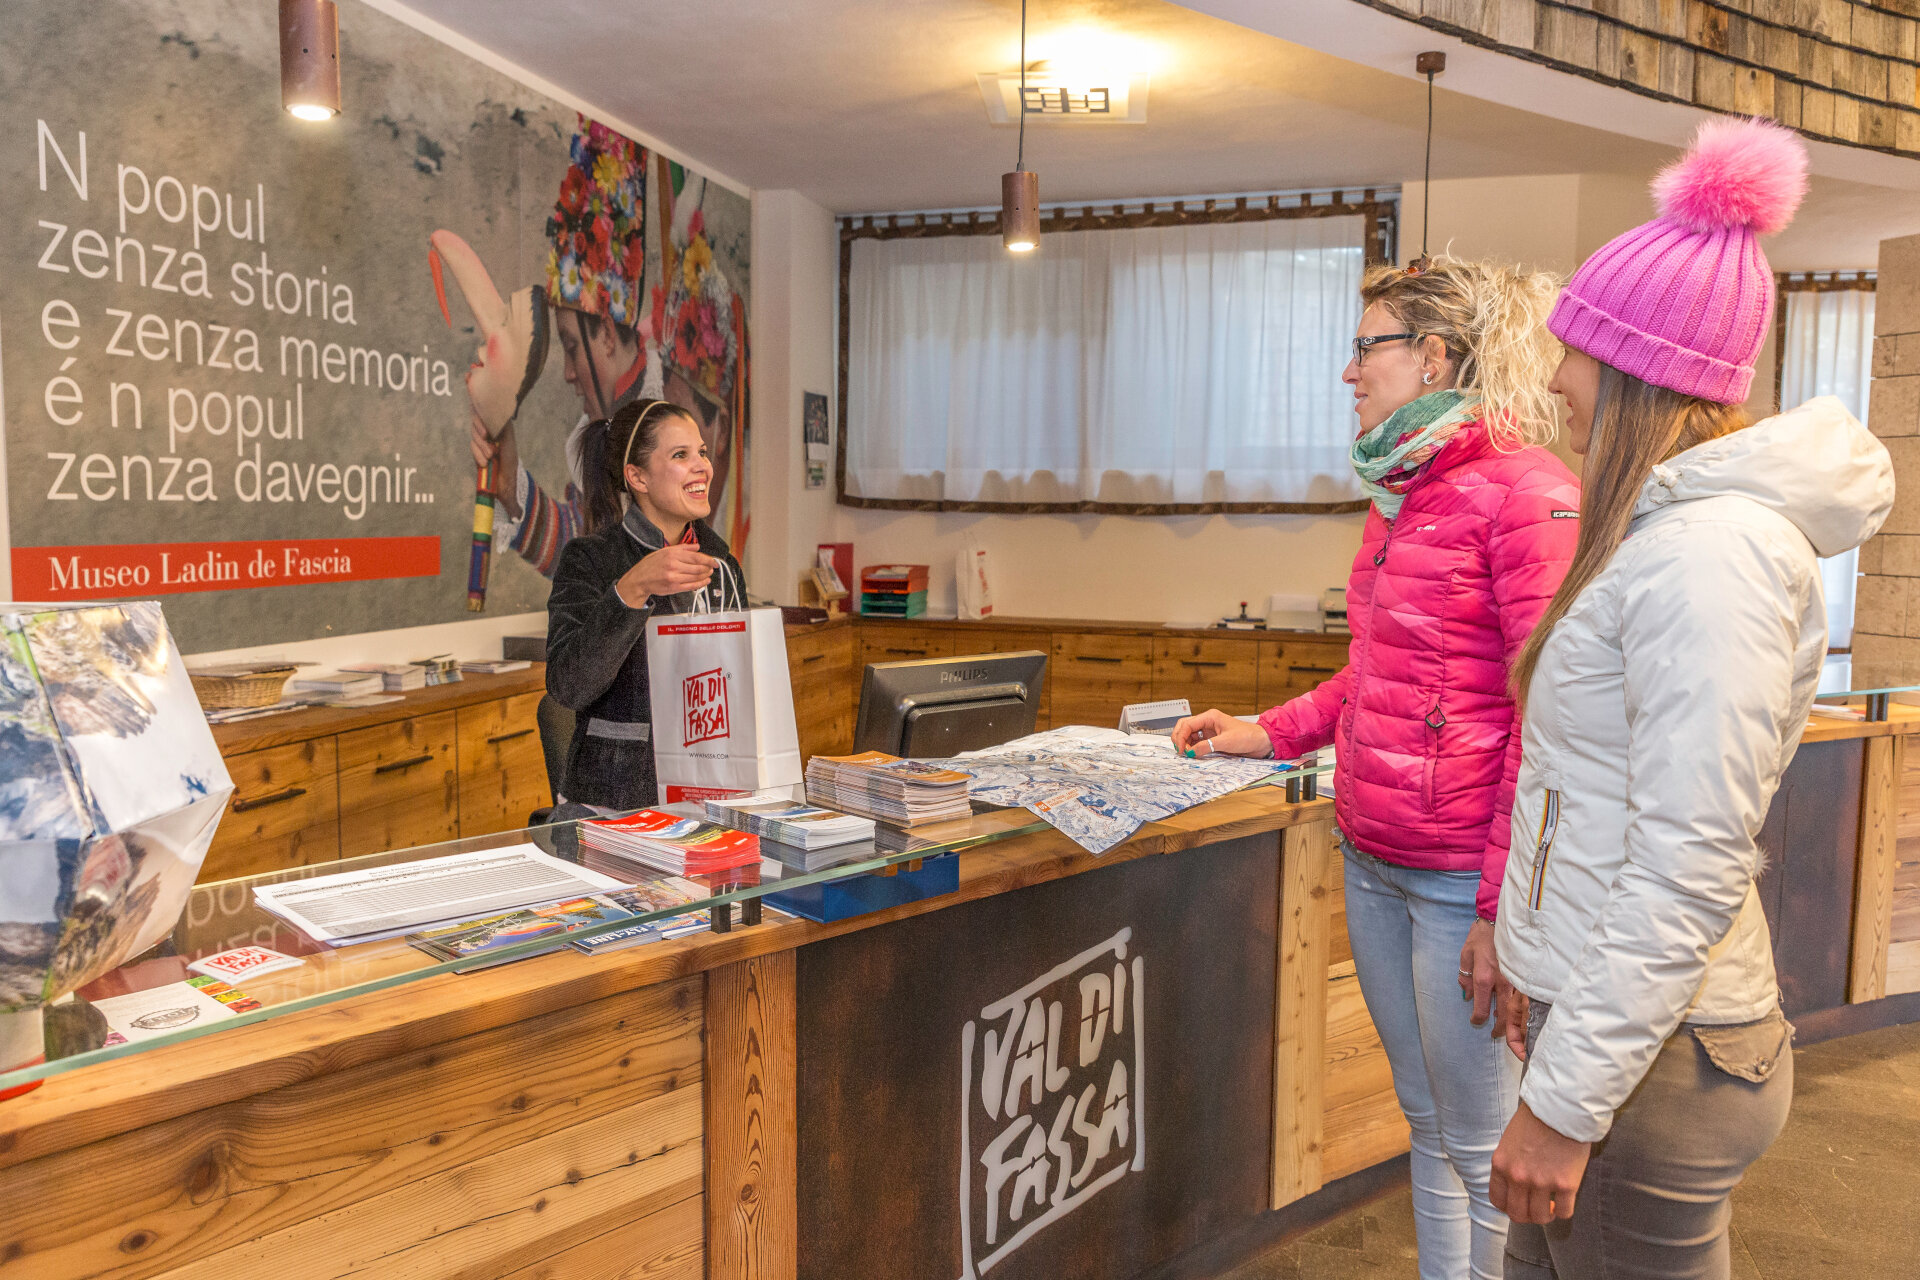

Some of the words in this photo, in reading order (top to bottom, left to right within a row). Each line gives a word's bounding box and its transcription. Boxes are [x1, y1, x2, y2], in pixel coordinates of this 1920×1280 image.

[37, 118, 89, 200] N
[117, 162, 266, 250] popul
[37, 219, 213, 299] zenza
[230, 251, 357, 325] storia
[41, 299, 81, 349] e
[105, 306, 263, 373] zenza
[279, 333, 452, 397] memoria
[44, 356, 83, 426] é
[109, 380, 142, 429] n
[168, 382, 304, 456] popul
[46, 451, 217, 502] zenza
[234, 442, 435, 520] davegnir...
[48, 555, 151, 591] Museo
[159, 550, 240, 586] Ladin
[247, 549, 277, 579] de
[283, 547, 353, 578] Fascia
[687, 679, 706, 708] VAL
[940, 668, 989, 684] PHILIPS
[687, 704, 725, 738] FASSA
[585, 926, 649, 945] FLY-LINE
[981, 997, 1071, 1122] VAL
[979, 1059, 1130, 1245] FASSA
